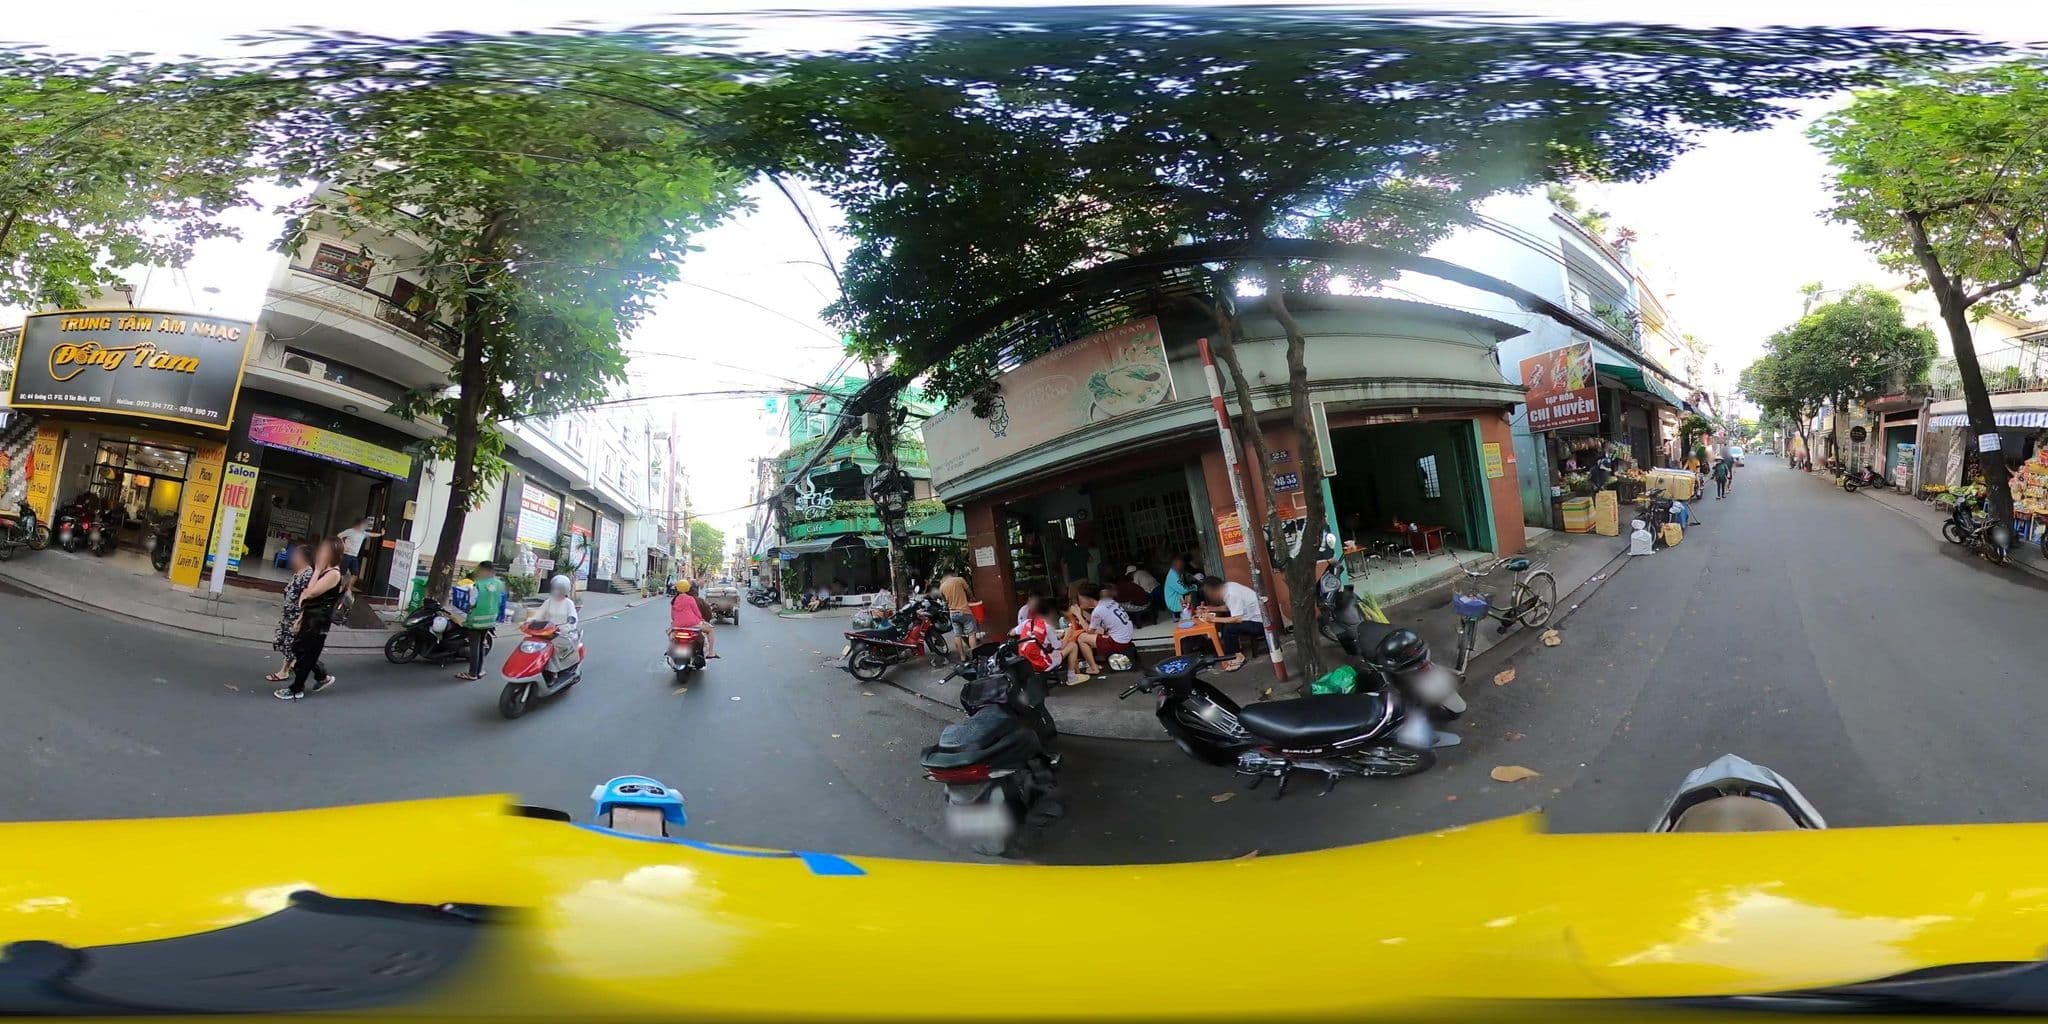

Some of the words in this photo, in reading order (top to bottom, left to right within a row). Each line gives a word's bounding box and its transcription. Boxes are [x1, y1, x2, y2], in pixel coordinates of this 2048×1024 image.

[59, 317, 111, 332] TRUNG
[118, 316, 153, 332] TÂM
[158, 315, 186, 334] ÂM
[192, 321, 241, 342] NHẠC
[55, 344, 126, 371] Đồng
[130, 343, 200, 373] Tâm
[1530, 407, 1550, 423] CHỊ
[1553, 396, 1595, 418] HUYỀN
[235, 451, 250, 463] 42
[228, 464, 256, 479] Salon
